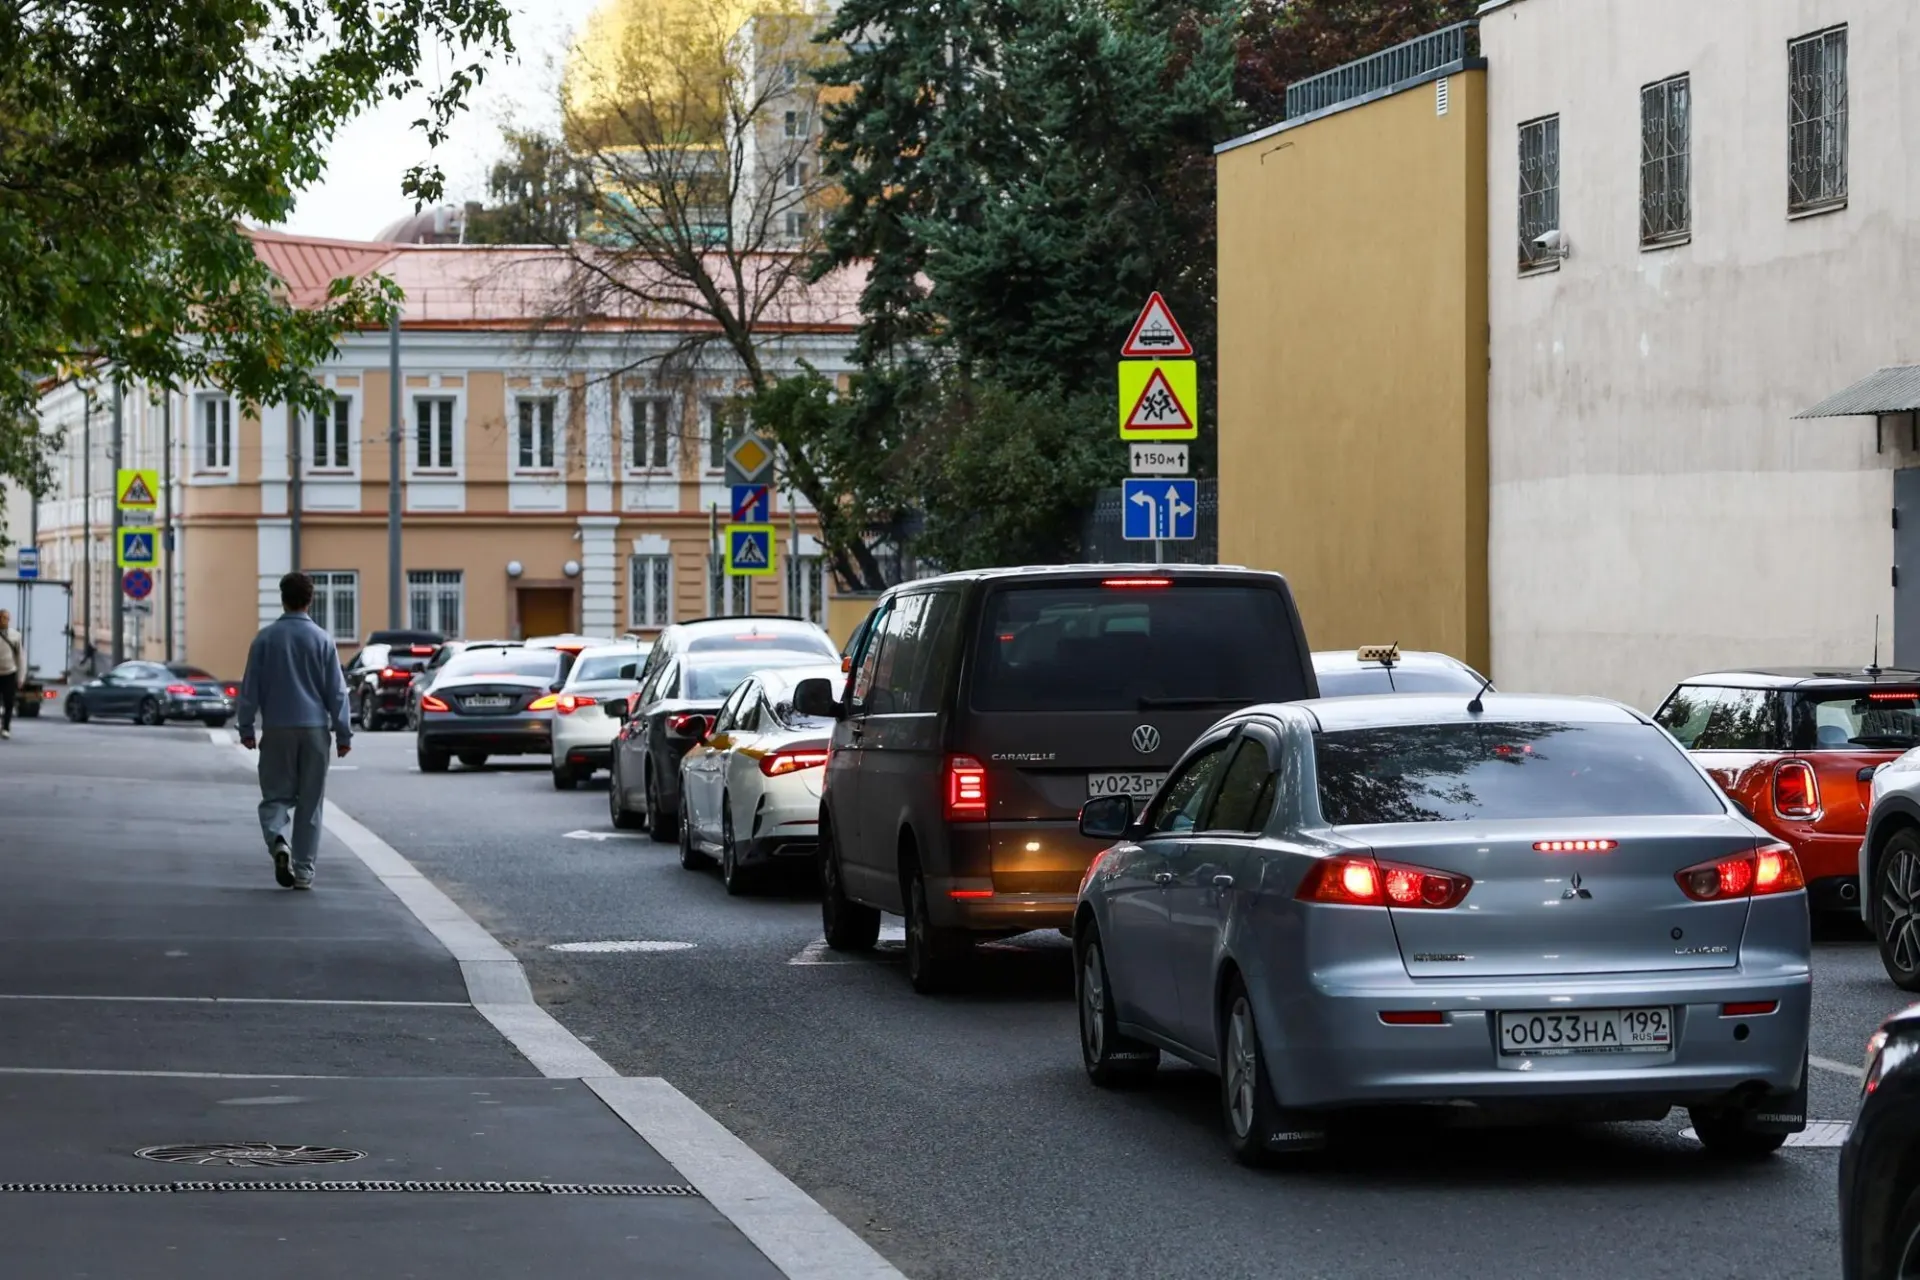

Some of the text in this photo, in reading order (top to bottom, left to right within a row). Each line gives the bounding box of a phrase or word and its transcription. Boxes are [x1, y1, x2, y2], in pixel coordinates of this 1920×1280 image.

[991, 753, 1056, 761] CARAVELLE
[1623, 1011, 1663, 1033] 199
[1632, 1032, 1652, 1041] RUS
[1278, 1131, 1325, 1141] MITSU
